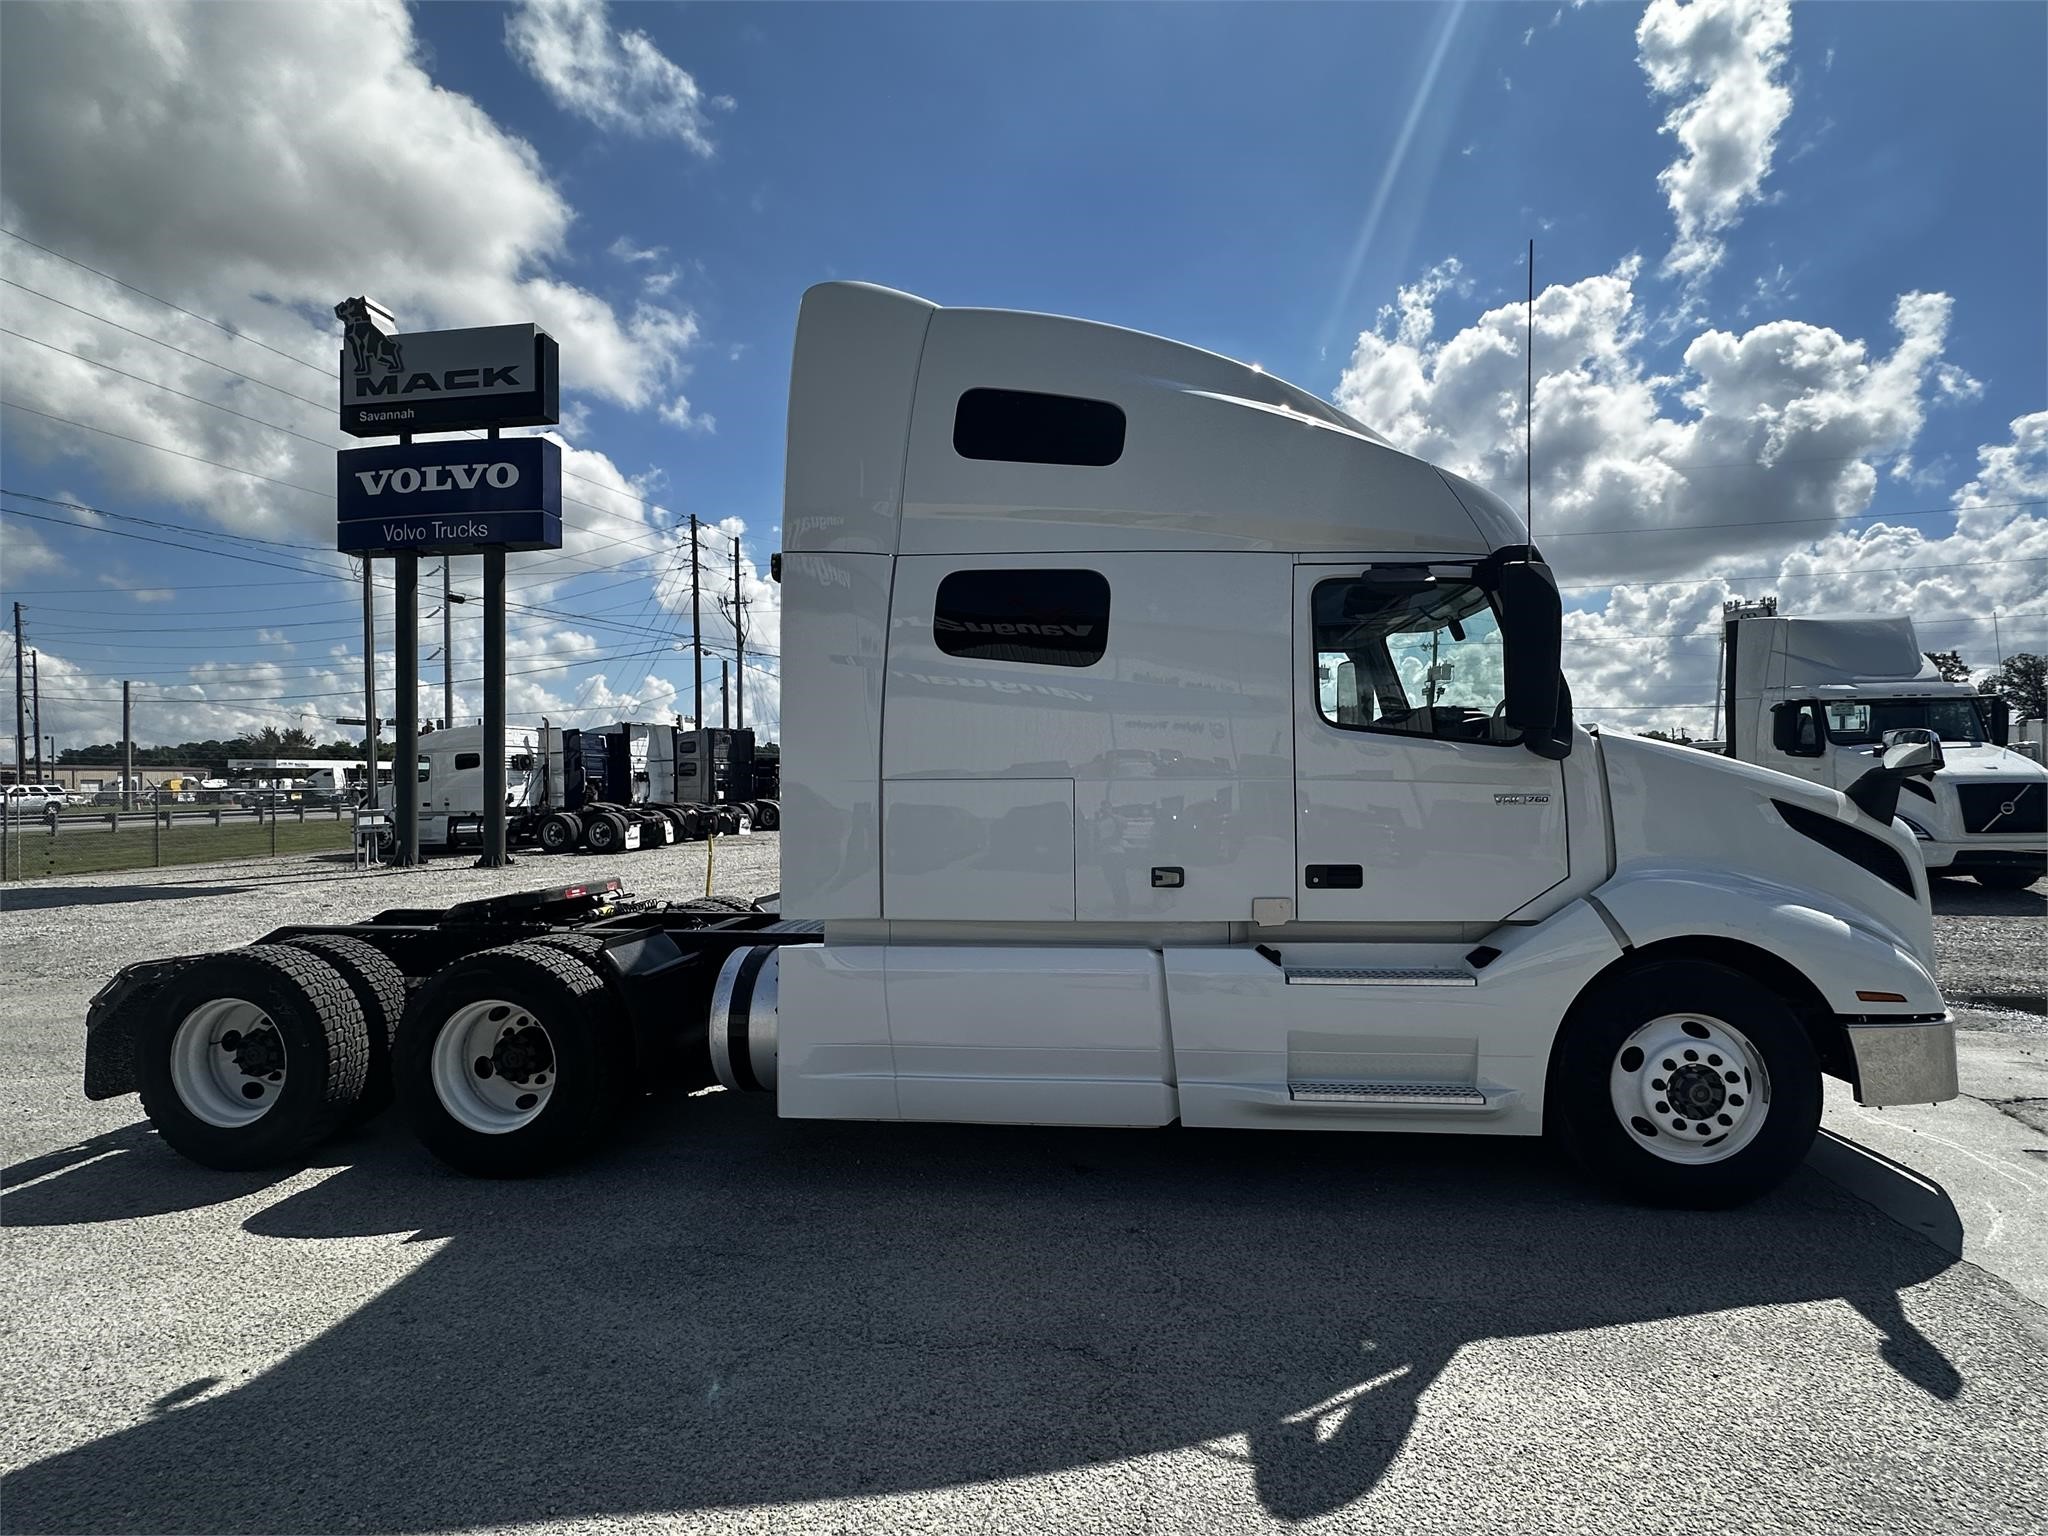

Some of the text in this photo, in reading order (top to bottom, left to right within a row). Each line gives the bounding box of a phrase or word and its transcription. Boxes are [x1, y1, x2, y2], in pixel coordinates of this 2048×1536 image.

[356, 365, 521, 397] MACK
[359, 408, 415, 422] Savannah
[355, 462, 520, 496] VOLVO
[383, 520, 488, 541] Volvo Trucks
